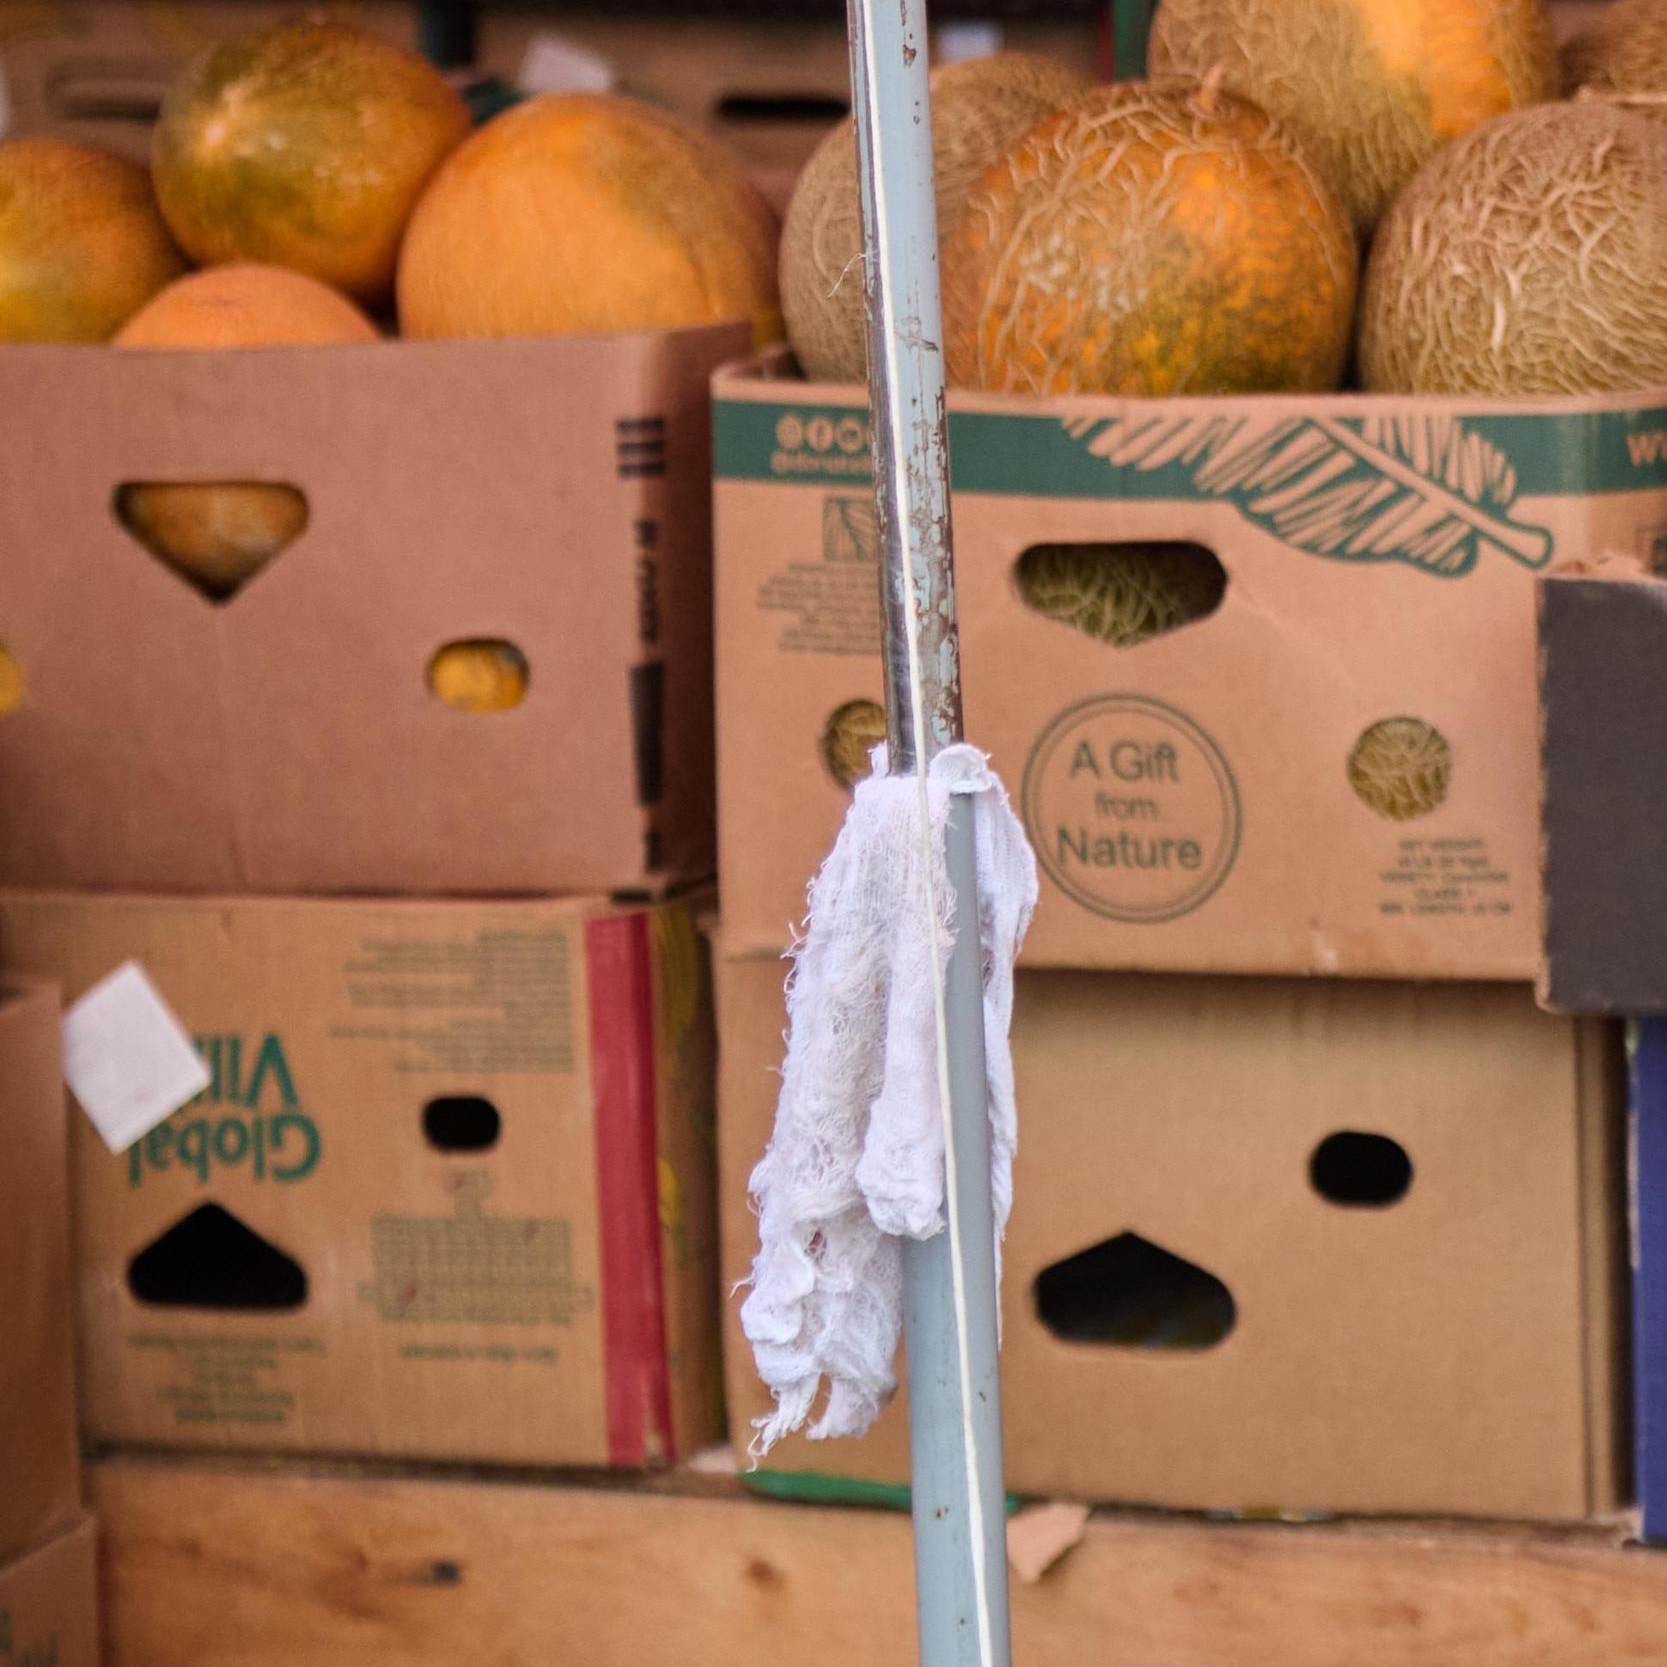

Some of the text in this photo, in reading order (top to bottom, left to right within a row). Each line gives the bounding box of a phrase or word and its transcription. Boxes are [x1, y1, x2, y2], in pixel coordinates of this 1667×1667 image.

[1069, 738, 1180, 783] A Gift
[1094, 789, 1159, 822] from
[1056, 824, 1204, 872] Nature
[128, 1112, 324, 1188] Global
